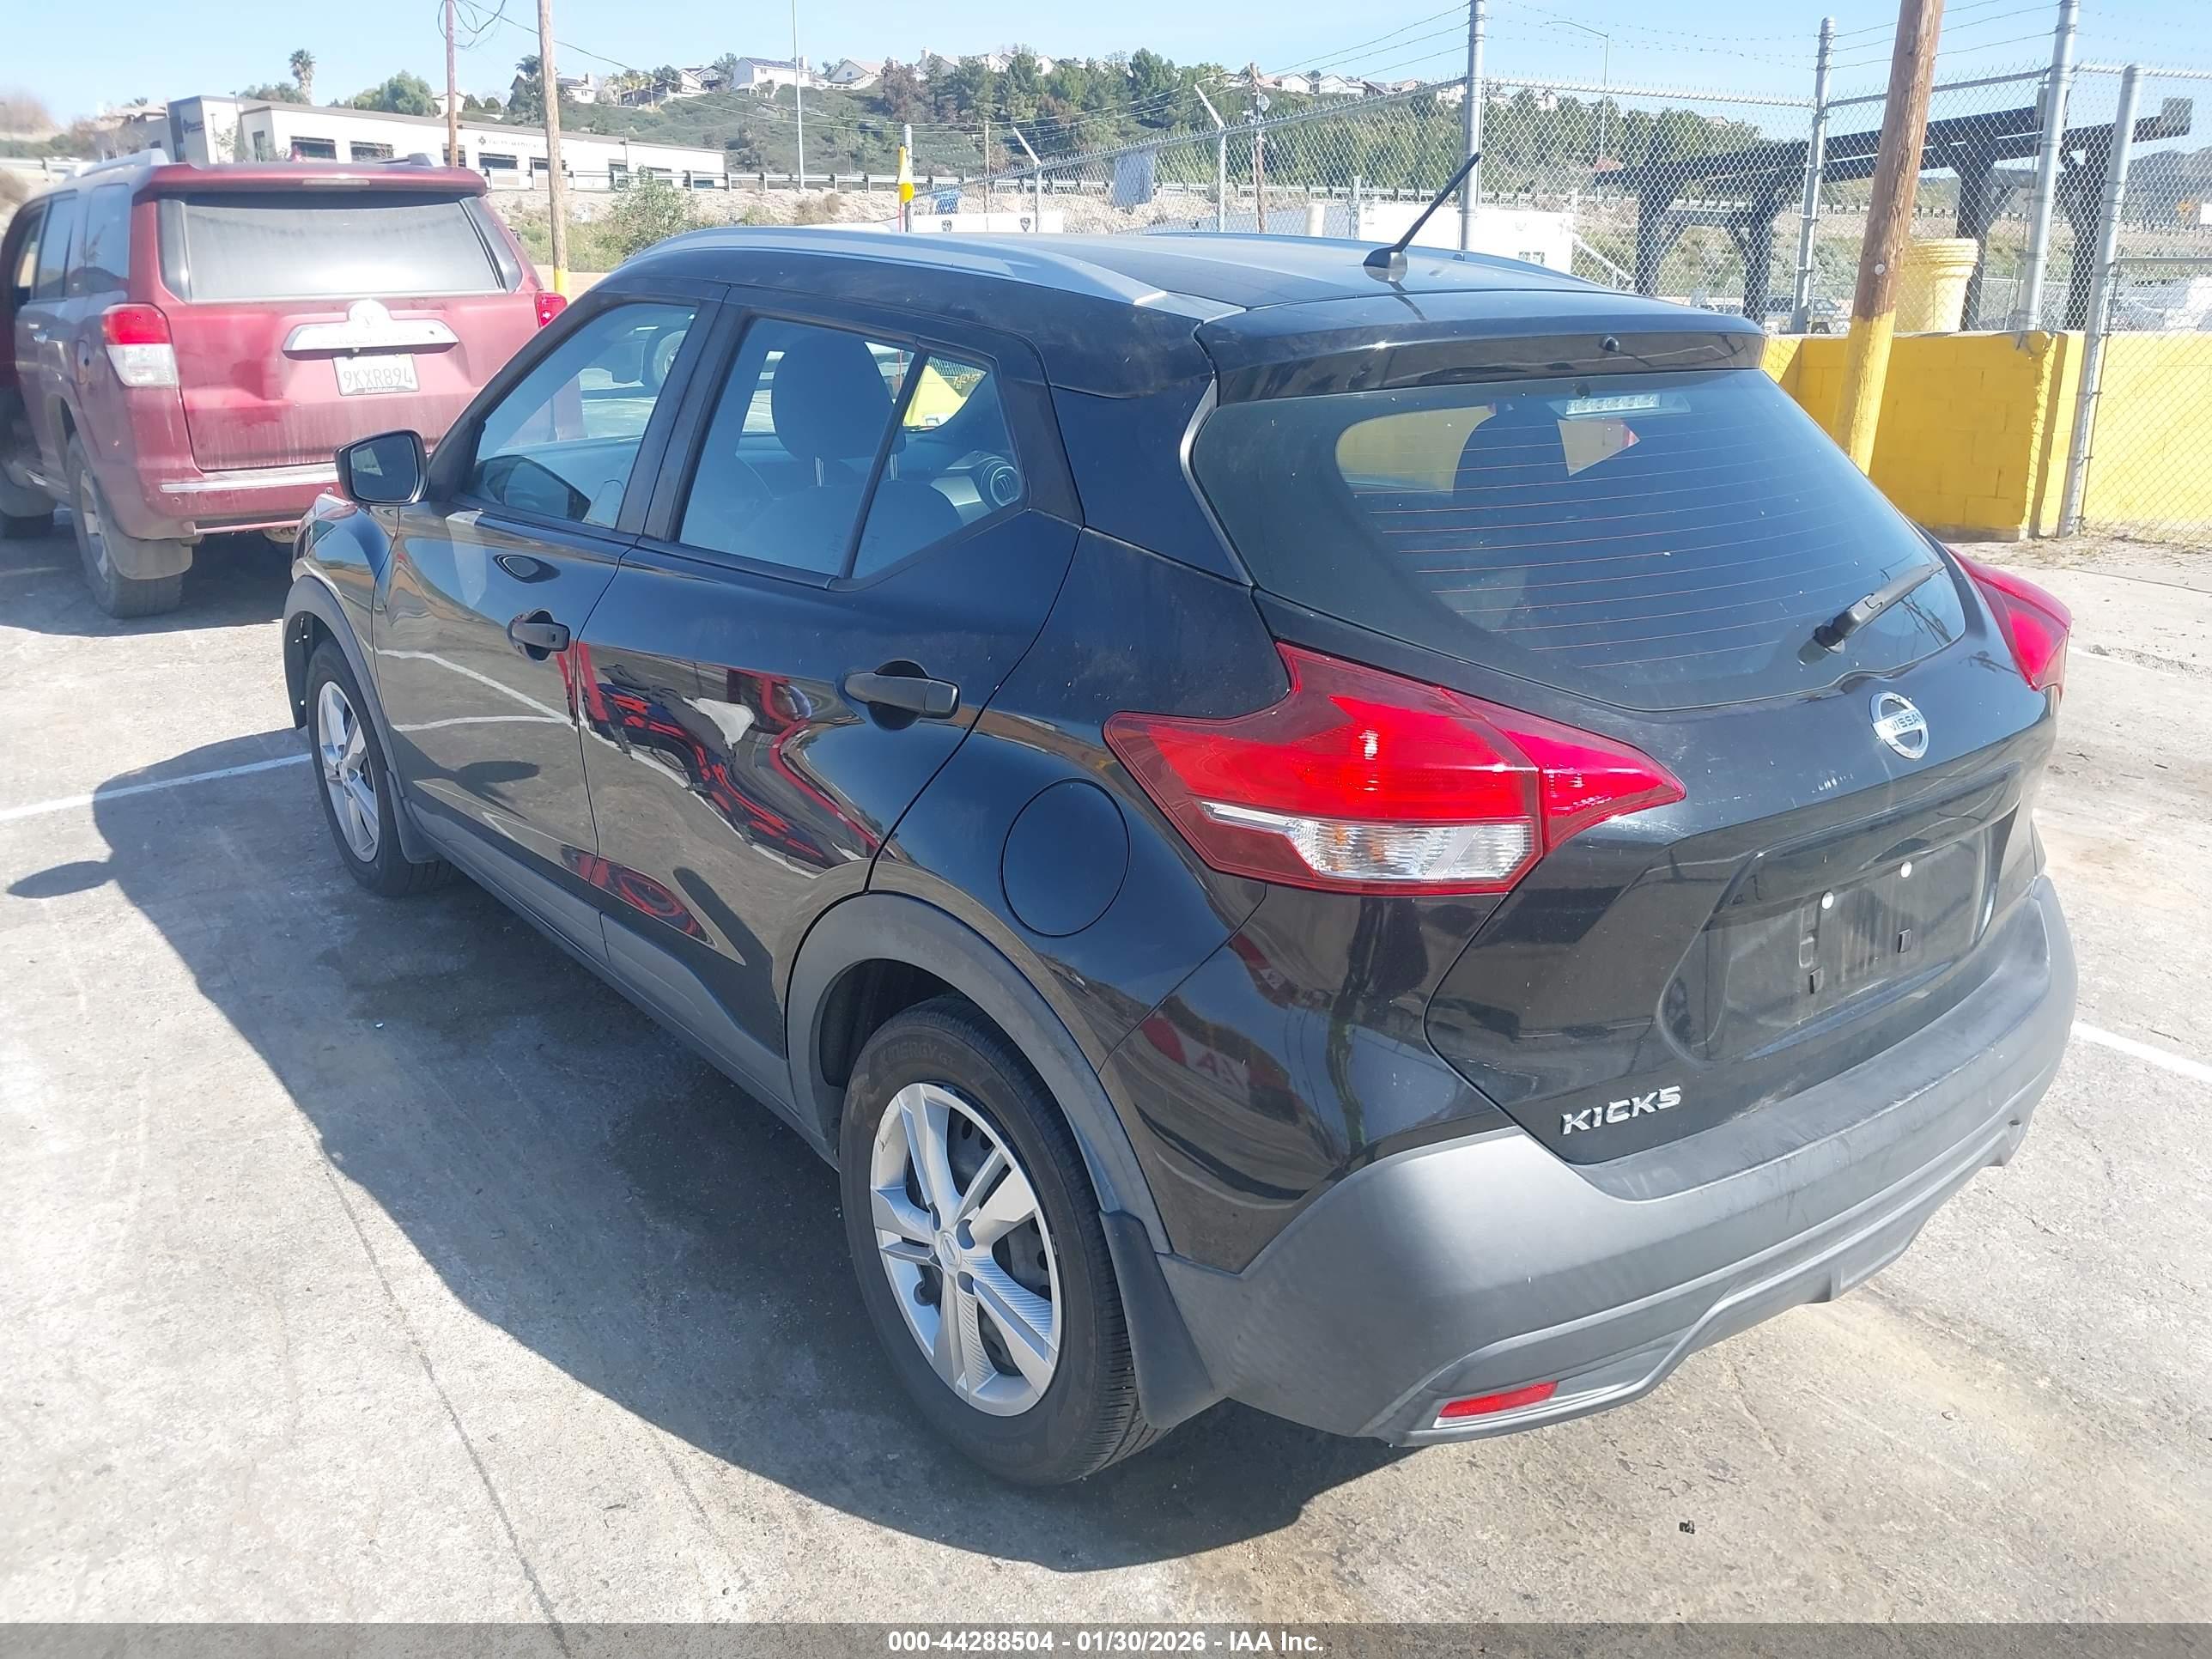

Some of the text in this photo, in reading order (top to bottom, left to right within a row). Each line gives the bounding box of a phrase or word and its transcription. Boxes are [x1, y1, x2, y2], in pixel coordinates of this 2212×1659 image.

[343, 367, 413, 389] 9KXR894
[1884, 712, 1924, 731] NISSAN
[1562, 1085, 1681, 1135] KICKS
